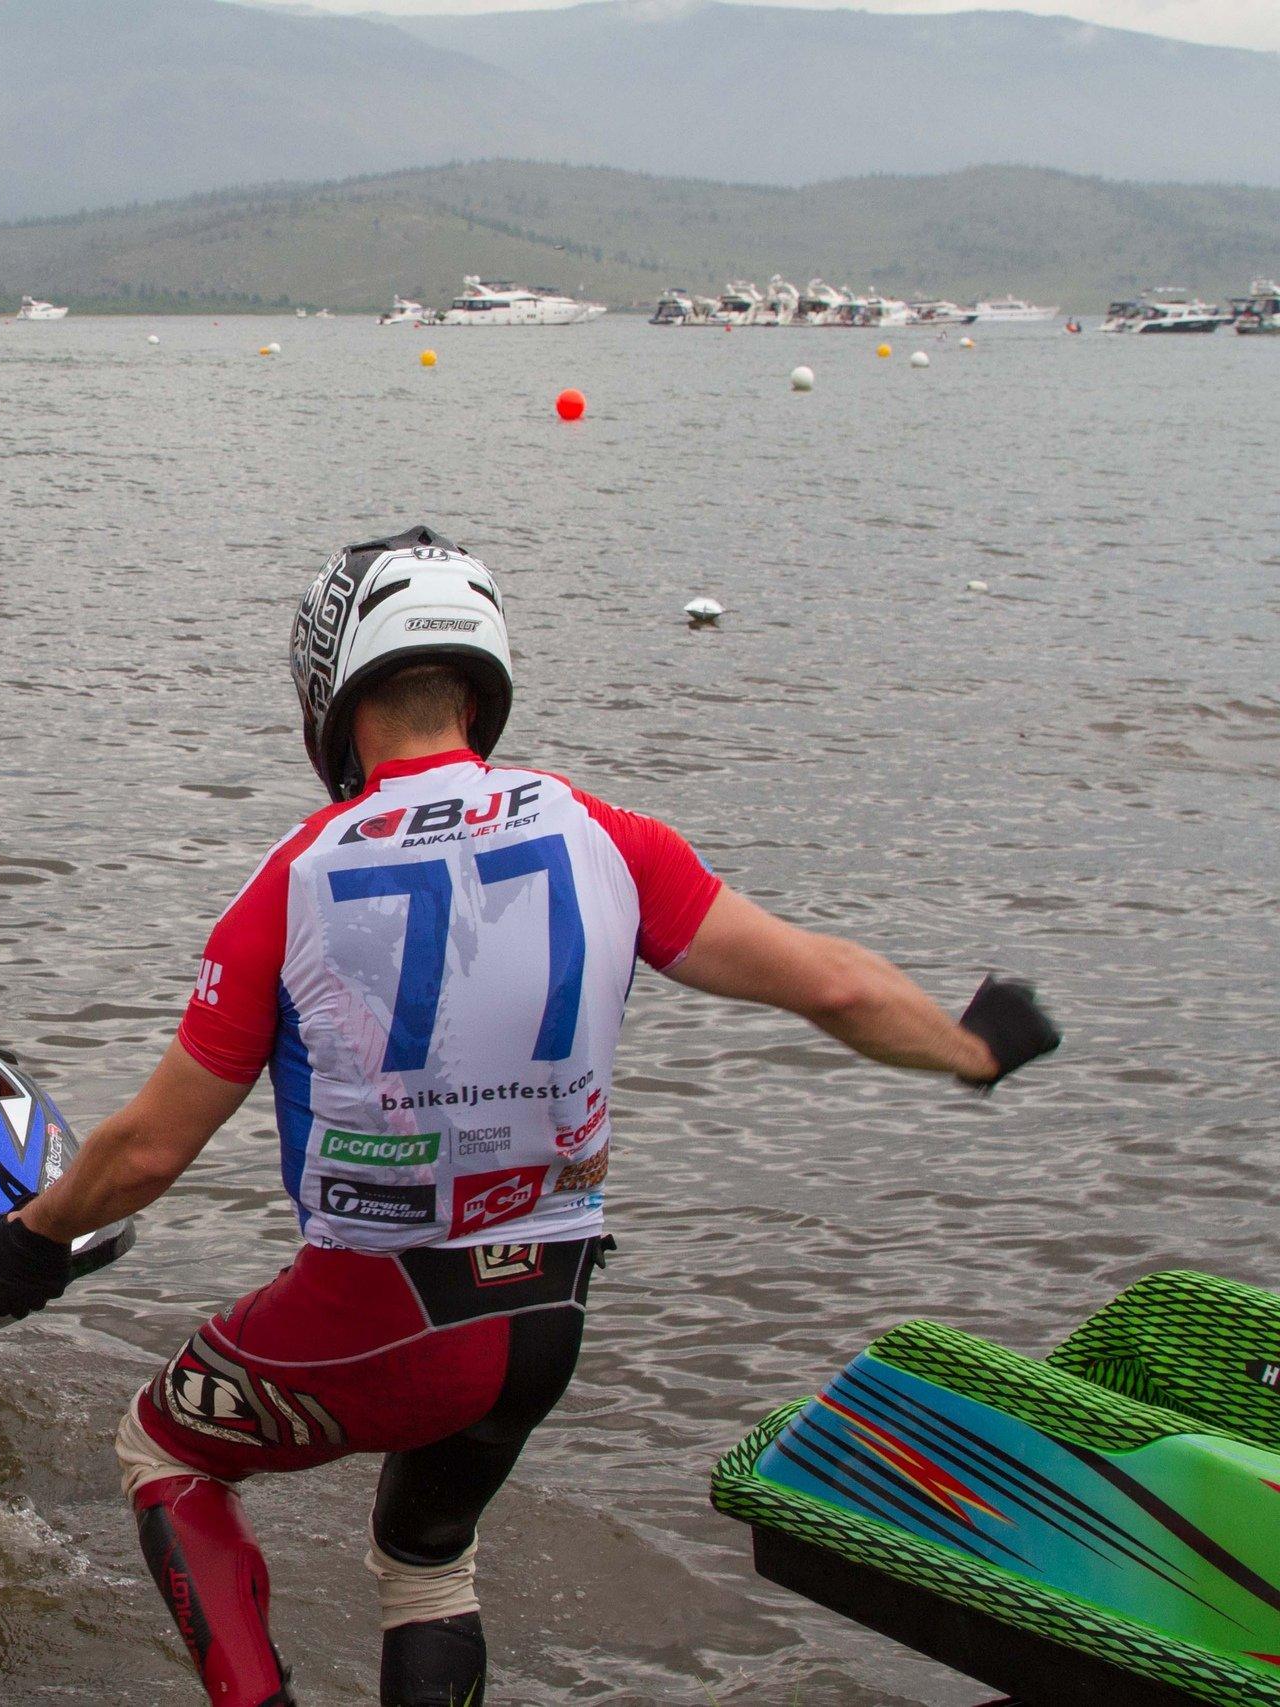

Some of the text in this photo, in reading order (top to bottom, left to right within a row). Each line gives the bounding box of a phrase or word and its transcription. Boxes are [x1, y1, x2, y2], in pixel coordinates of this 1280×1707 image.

[406, 780, 542, 836] BJF
[401, 812, 541, 848] BAIKAL JET FEST
[327, 834, 586, 1073] 77
[381, 1069, 594, 1111] baikaljetfest.com
[459, 1126, 511, 1143] РОССИЯ
[459, 1140, 511, 1156] СЕГОДНЯ
